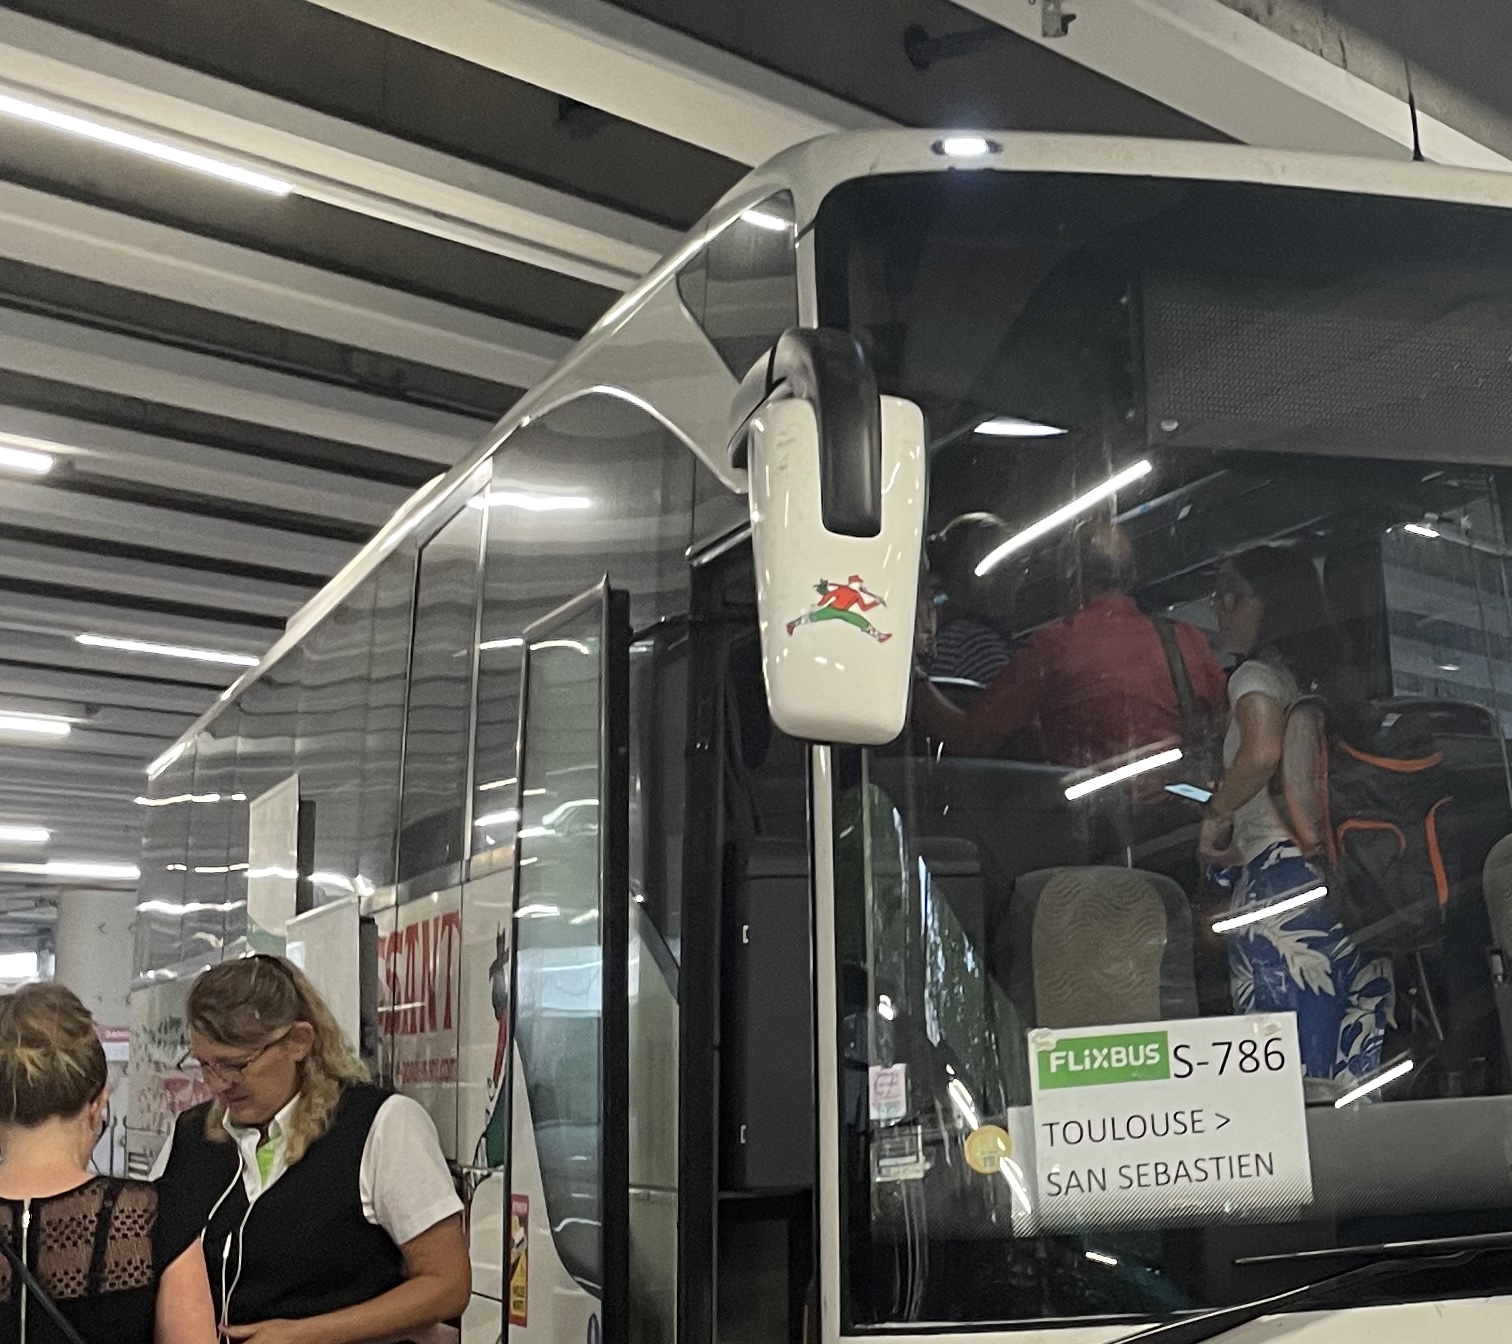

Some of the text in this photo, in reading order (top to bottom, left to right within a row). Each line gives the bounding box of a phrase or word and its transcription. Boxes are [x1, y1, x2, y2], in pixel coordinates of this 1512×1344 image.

[1172, 1037, 1286, 1079] S-786
[1042, 1109, 1206, 1149] TOULOUSE
[1047, 1152, 1275, 1197] SAN SEBASTIEN
